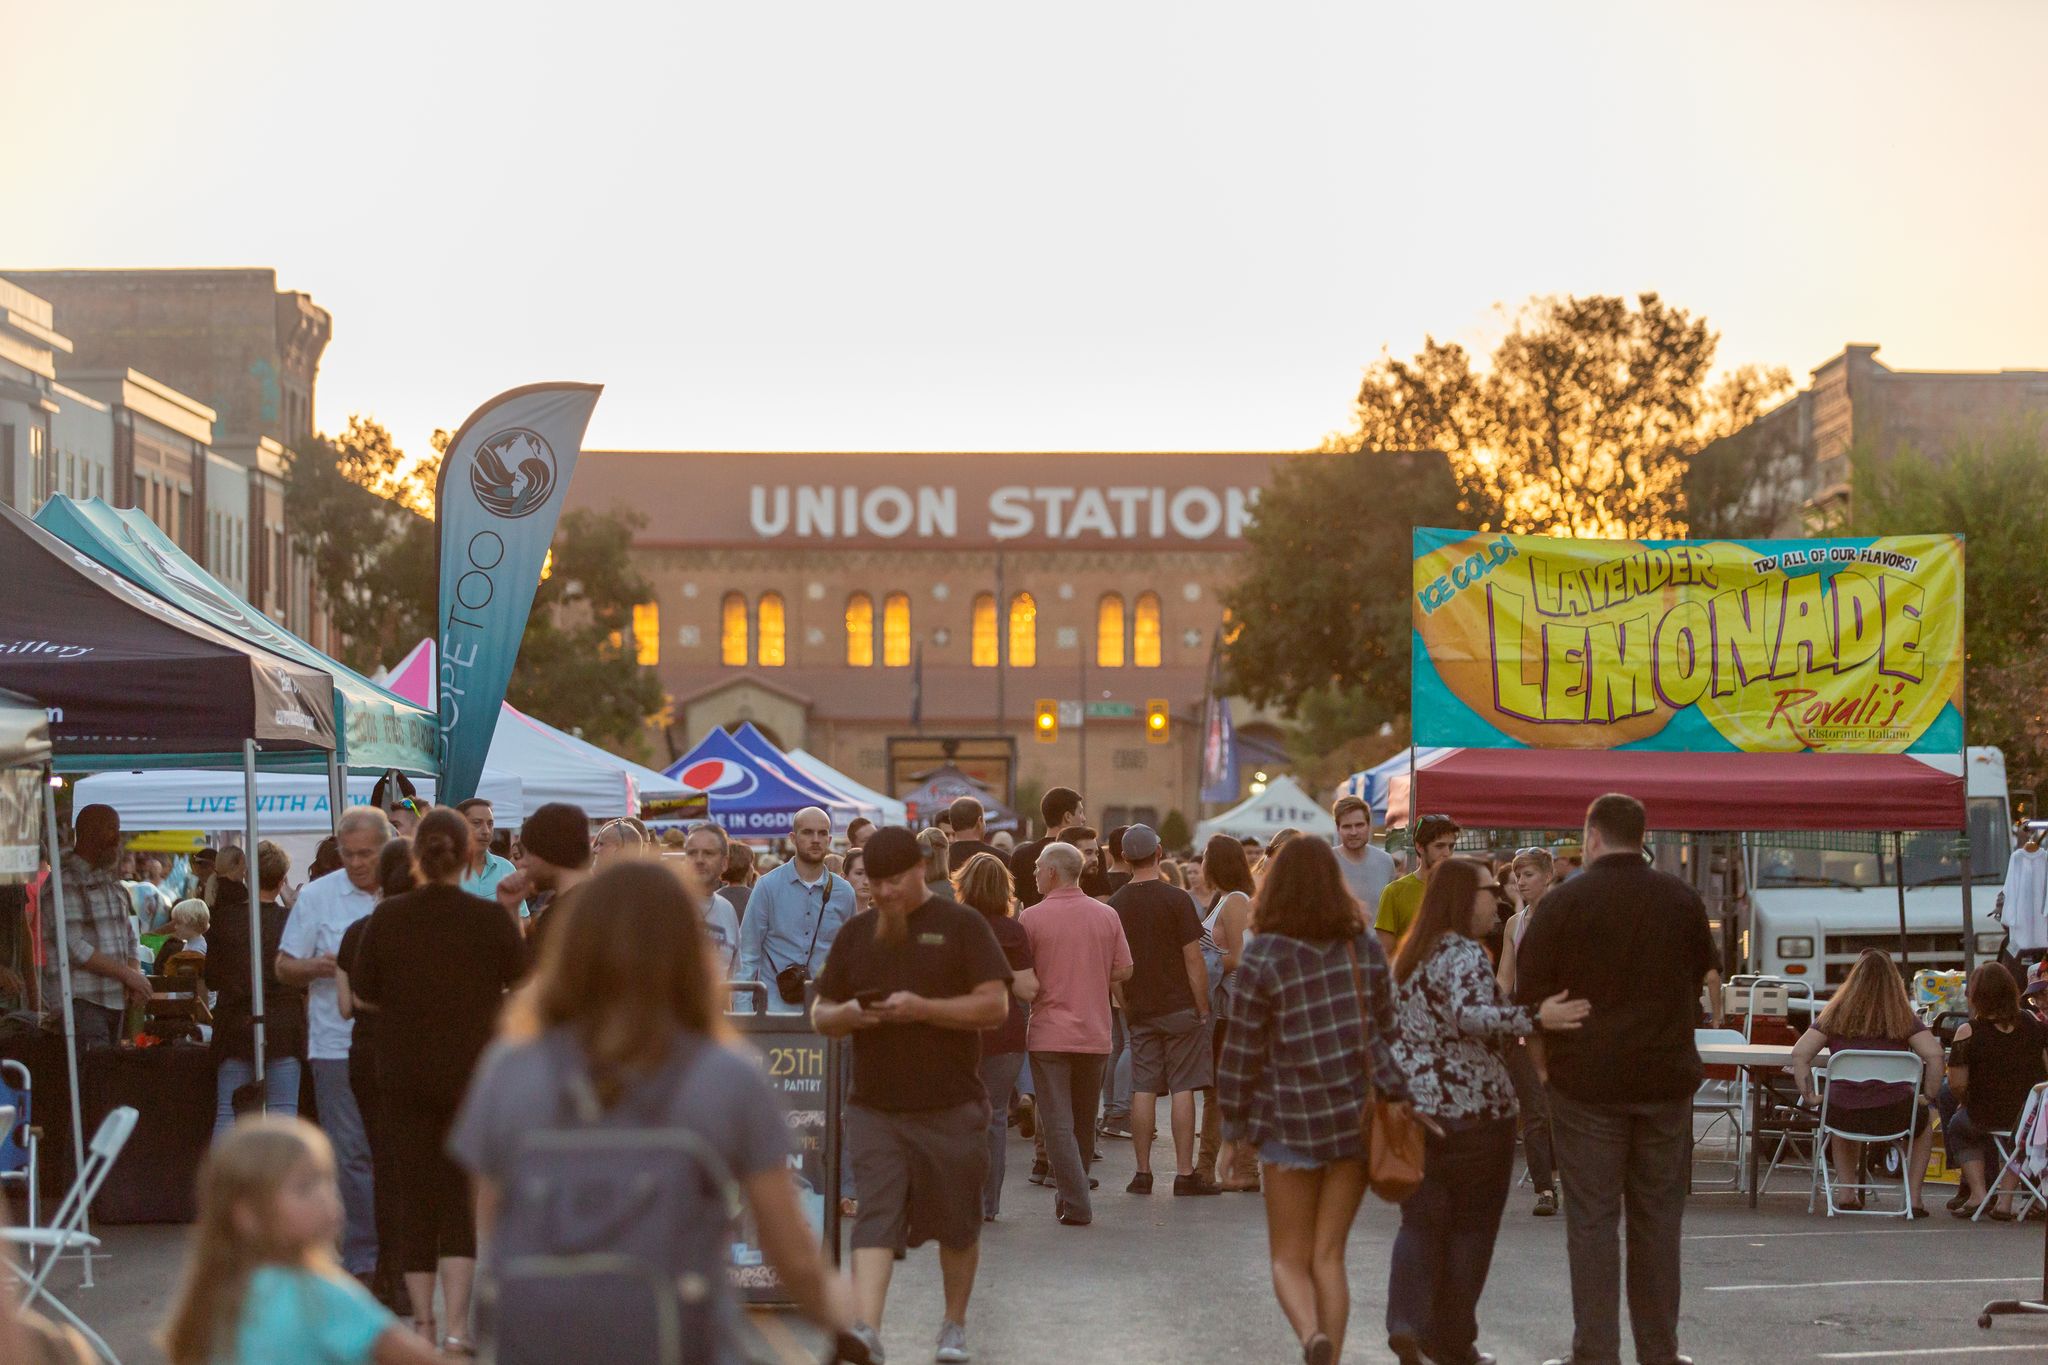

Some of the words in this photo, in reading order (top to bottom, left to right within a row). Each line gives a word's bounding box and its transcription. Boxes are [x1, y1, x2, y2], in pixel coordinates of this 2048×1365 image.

[750, 485, 957, 538] UNION
[988, 486, 1258, 539] STATION
[448, 530, 504, 630] TOO
[1417, 575, 1456, 614] ICE
[1452, 535, 1519, 590] COLD!
[1529, 546, 1719, 617] LAVENDER
[1754, 556, 1777, 574] TRY
[1783, 551, 1806, 566] ALL
[1811, 549, 1826, 562] OF
[1831, 548, 1856, 561] OUR
[1860, 550, 1918, 573] FLAVORS!
[1487, 571, 1925, 724] LEMONADE
[1766, 682, 1906, 748] Rovali's
[1808, 727, 1866, 740] Ristorante
[1868, 728, 1910, 740] Italiano
[186, 796, 238, 813] LIVE
[729, 812, 746, 828] IN
[749, 812, 794, 828] OGD
[768, 1048, 823, 1076] 25TH
[784, 1079, 822, 1092] PANTRY
